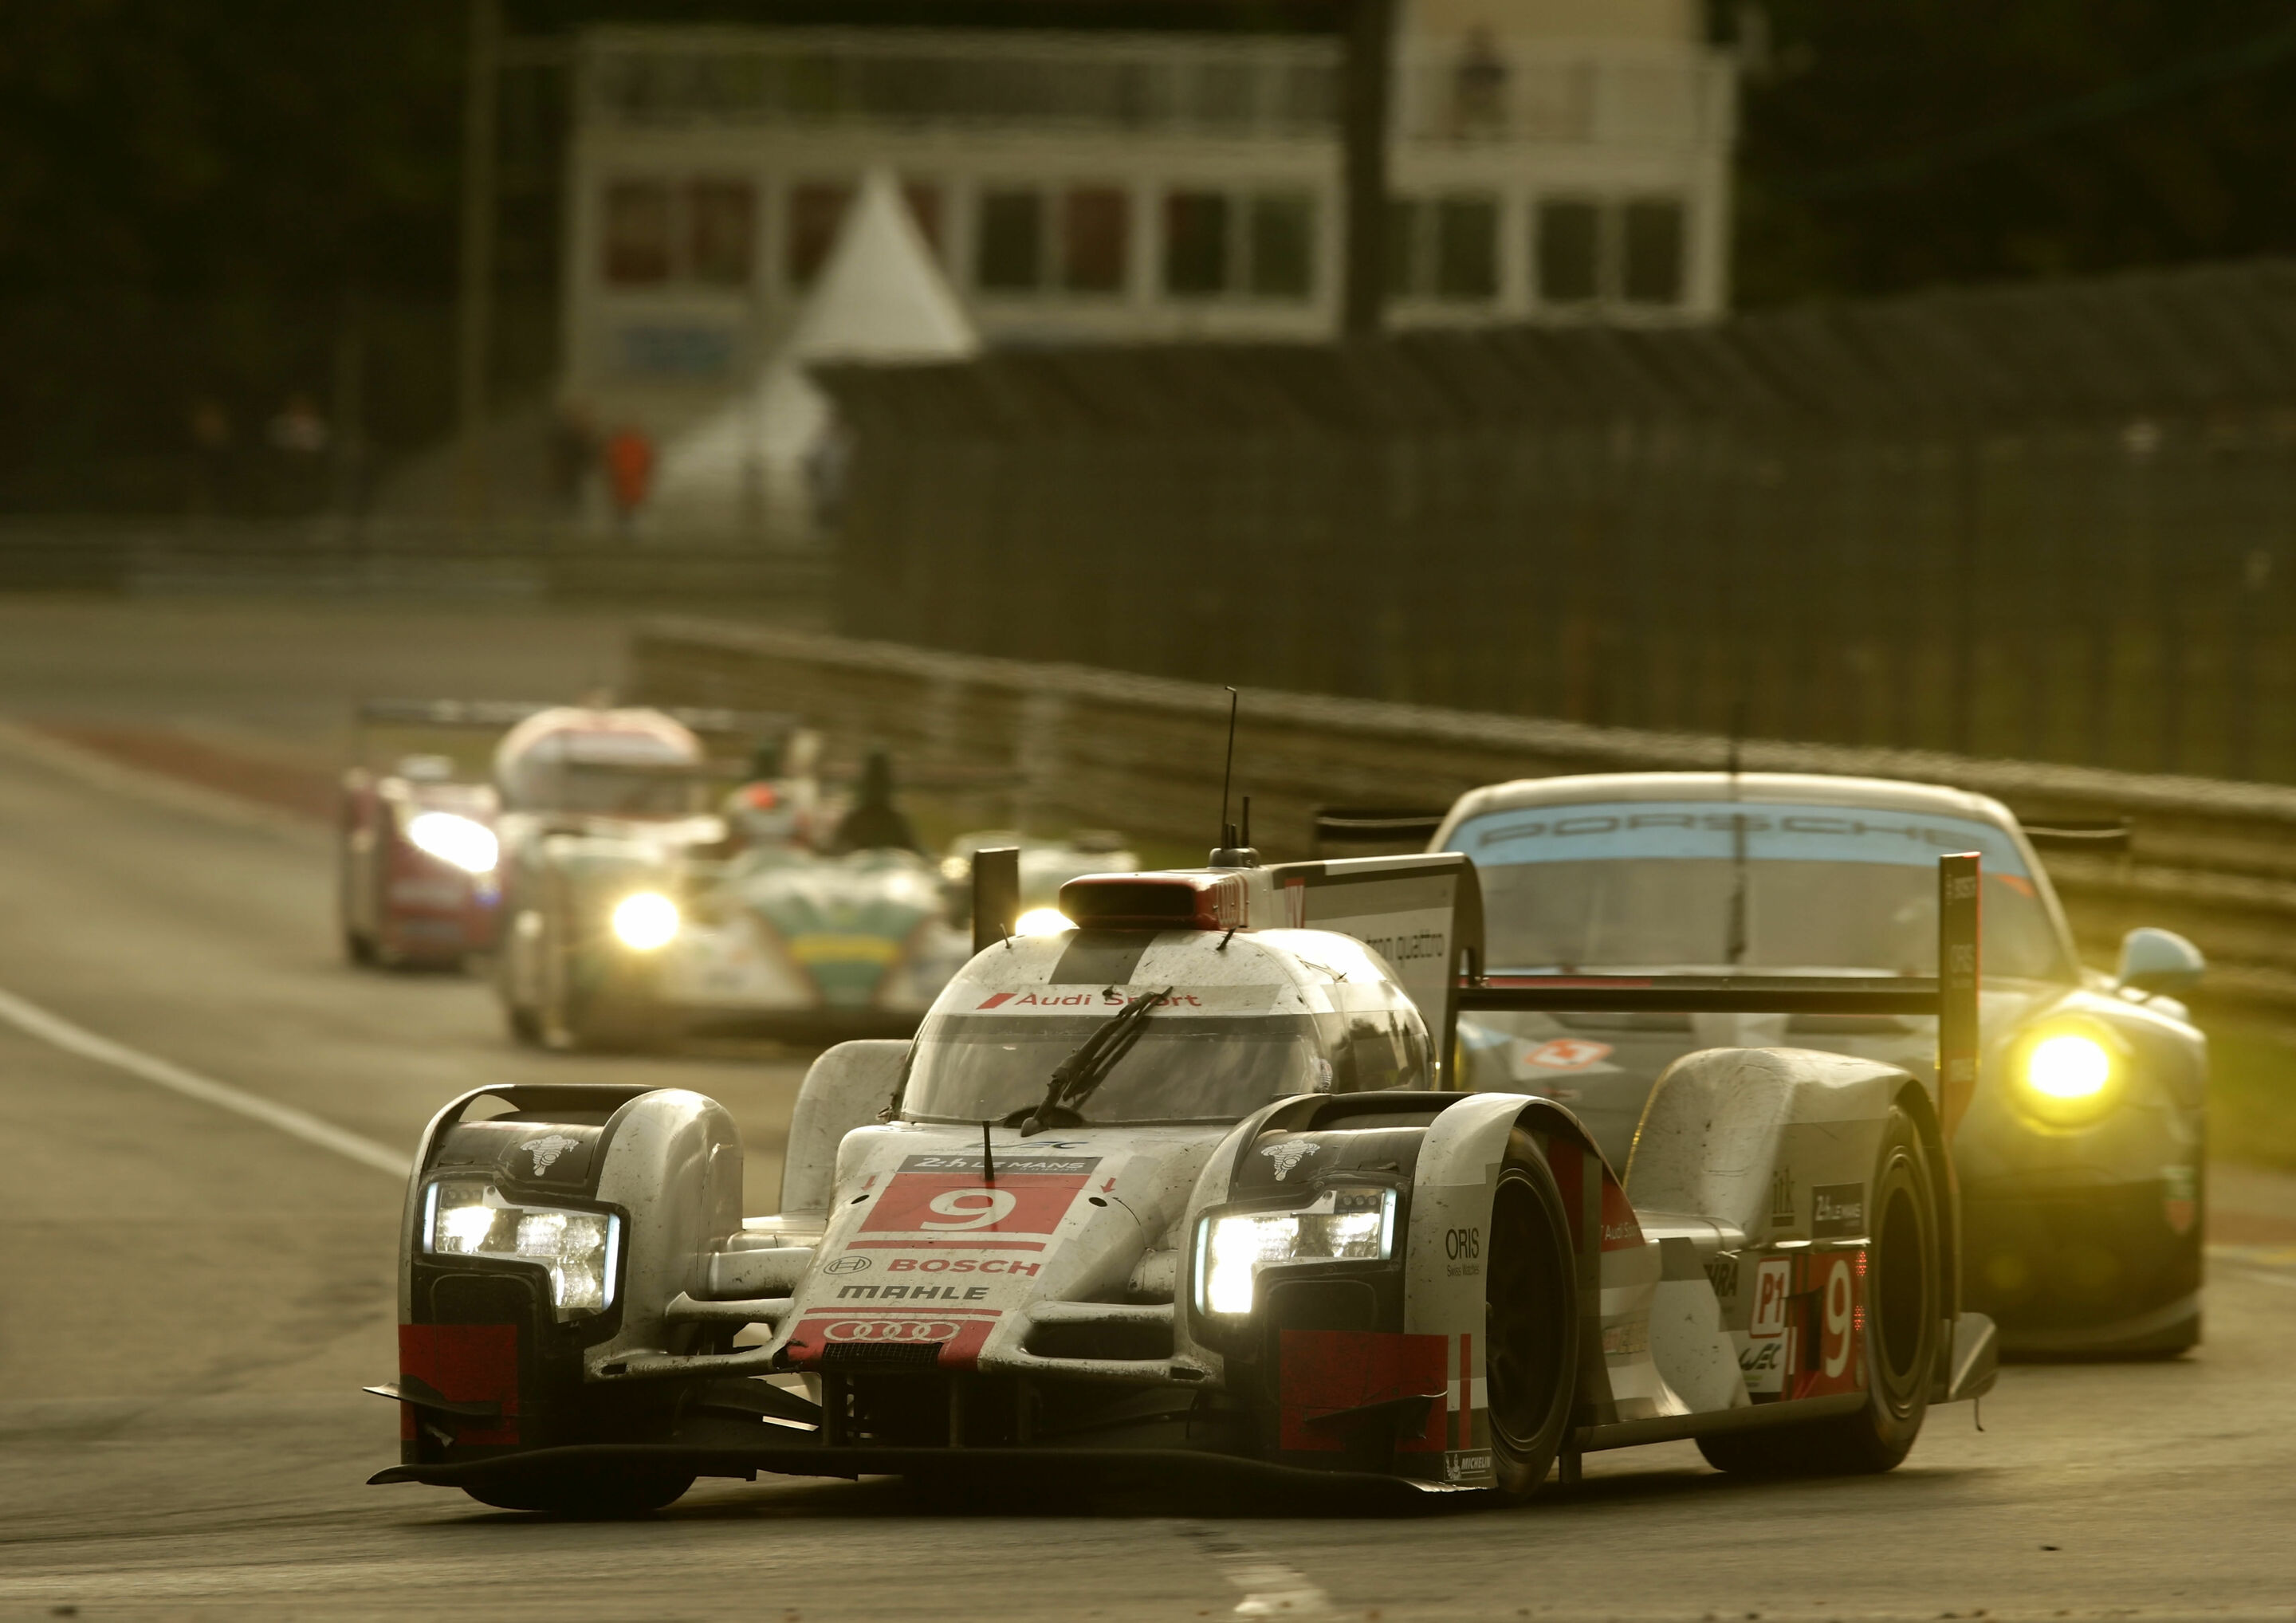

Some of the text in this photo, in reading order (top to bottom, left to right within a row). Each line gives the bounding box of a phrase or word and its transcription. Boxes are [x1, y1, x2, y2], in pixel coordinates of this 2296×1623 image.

[1477, 813, 1990, 854] PORSCHE
[1015, 992, 1201, 1007] Audi Sort
[920, 1189, 1016, 1231] 9
[1445, 1227, 1480, 1260] ORIS
[887, 1259, 1041, 1277] BOSCH
[837, 1285, 990, 1300] MAHLE
[1758, 1273, 1785, 1323] P1
[1826, 1260, 1851, 1377] 9
